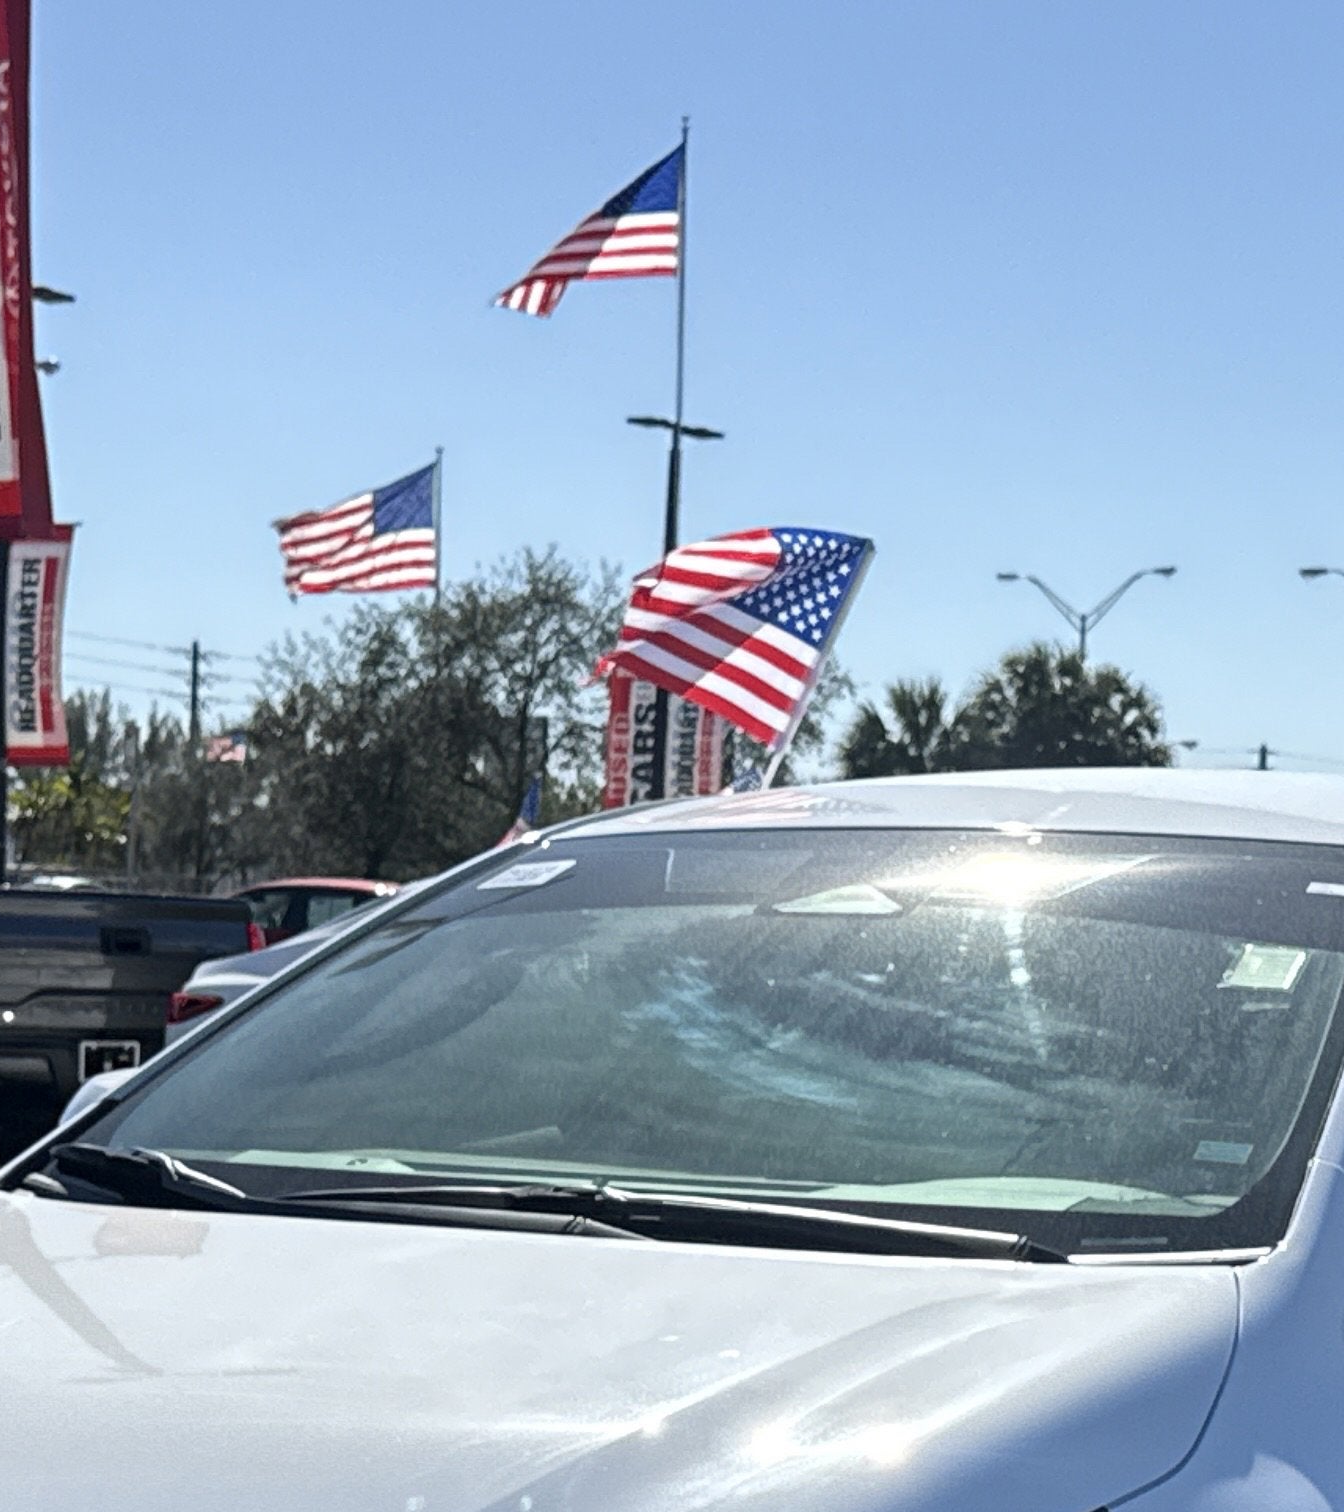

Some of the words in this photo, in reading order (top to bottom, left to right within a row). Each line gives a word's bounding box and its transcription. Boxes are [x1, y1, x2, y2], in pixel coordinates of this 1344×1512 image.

[17, 557, 42, 733] HEADQUARTER
[609, 712, 631, 795] USED
[629, 702, 657, 802] ARS
